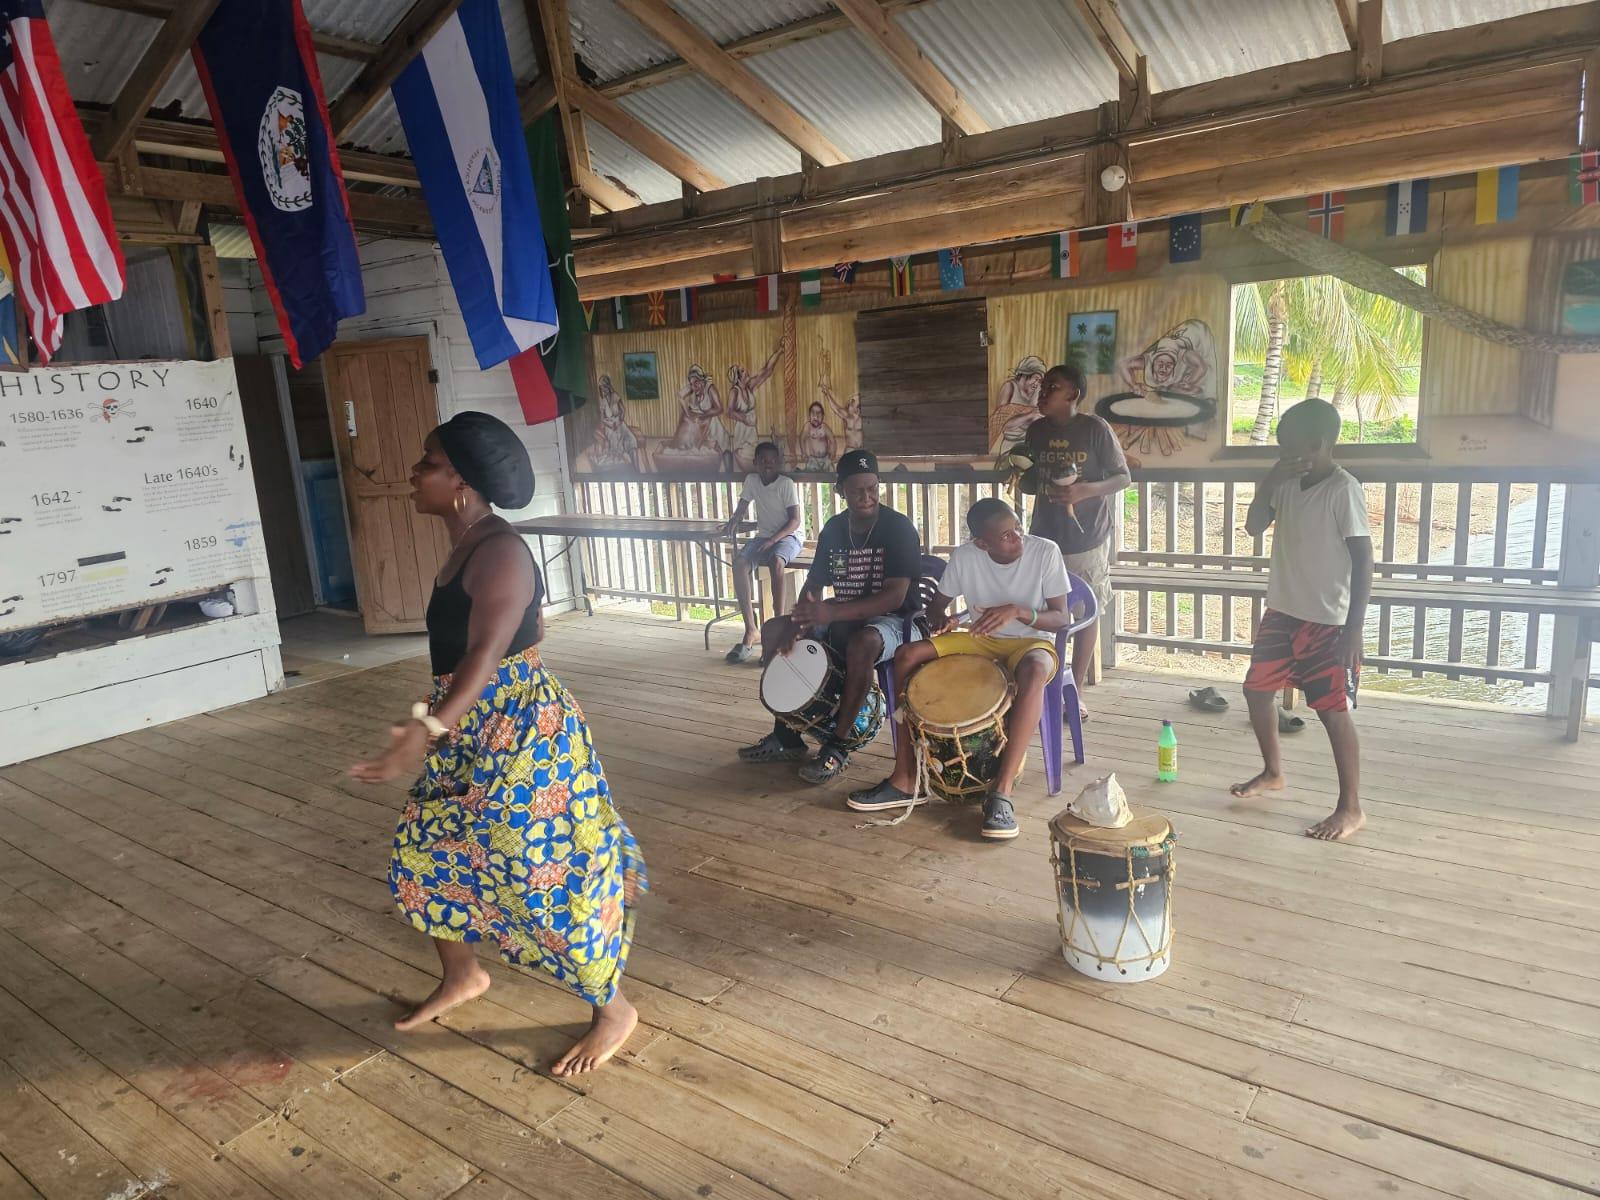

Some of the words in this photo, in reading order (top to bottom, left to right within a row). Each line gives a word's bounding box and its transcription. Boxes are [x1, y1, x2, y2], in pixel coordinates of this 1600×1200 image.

[0, 369, 169, 397] HISTORY
[185, 397, 217, 410] 1640
[9, 408, 84, 424] 1580-1636
[1039, 451, 1087, 463] EGEND
[145, 472, 173, 484] Late
[177, 465, 218, 480] 1640's
[184, 536, 216, 551] 1859
[38, 570, 76, 587] 1797
